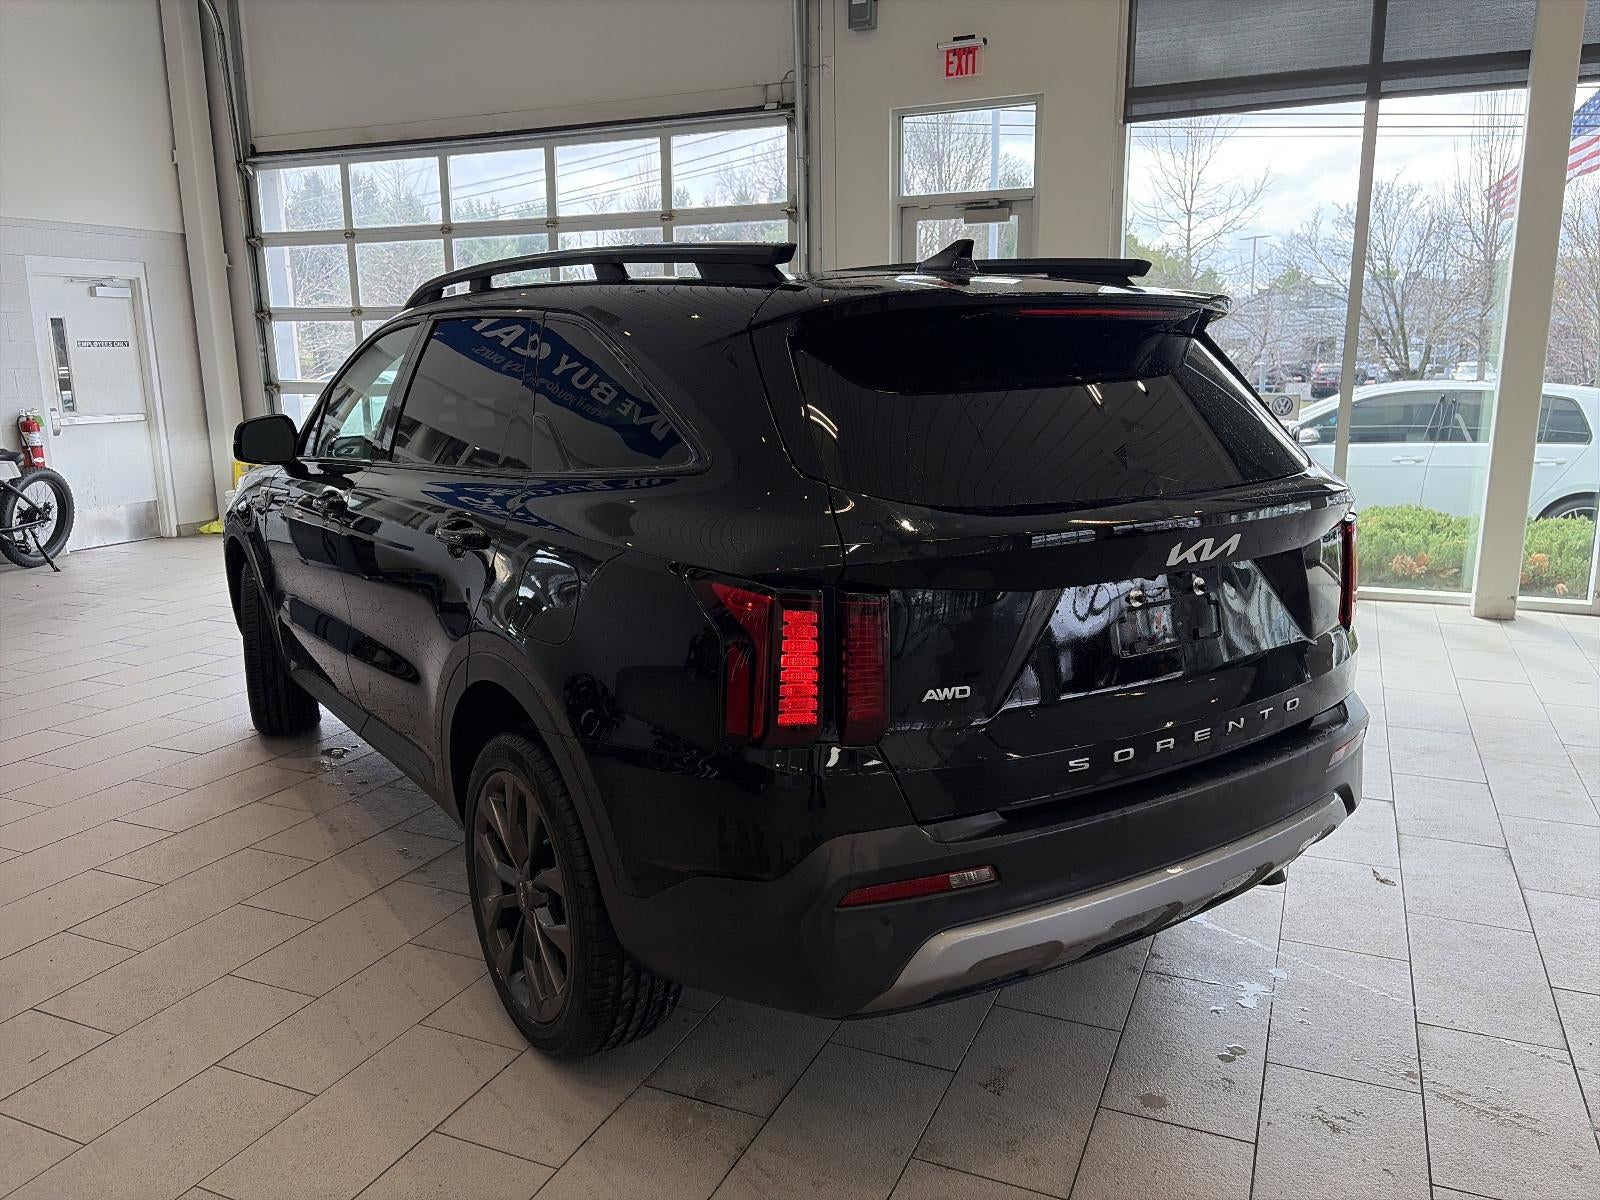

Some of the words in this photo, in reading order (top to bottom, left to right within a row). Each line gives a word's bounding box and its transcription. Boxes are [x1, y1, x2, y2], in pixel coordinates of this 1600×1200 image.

[945, 46, 978, 77] EXIT
[1166, 533, 1241, 566] KIA
[922, 686, 971, 702] AWD
[1068, 697, 1300, 773] SORENTO
